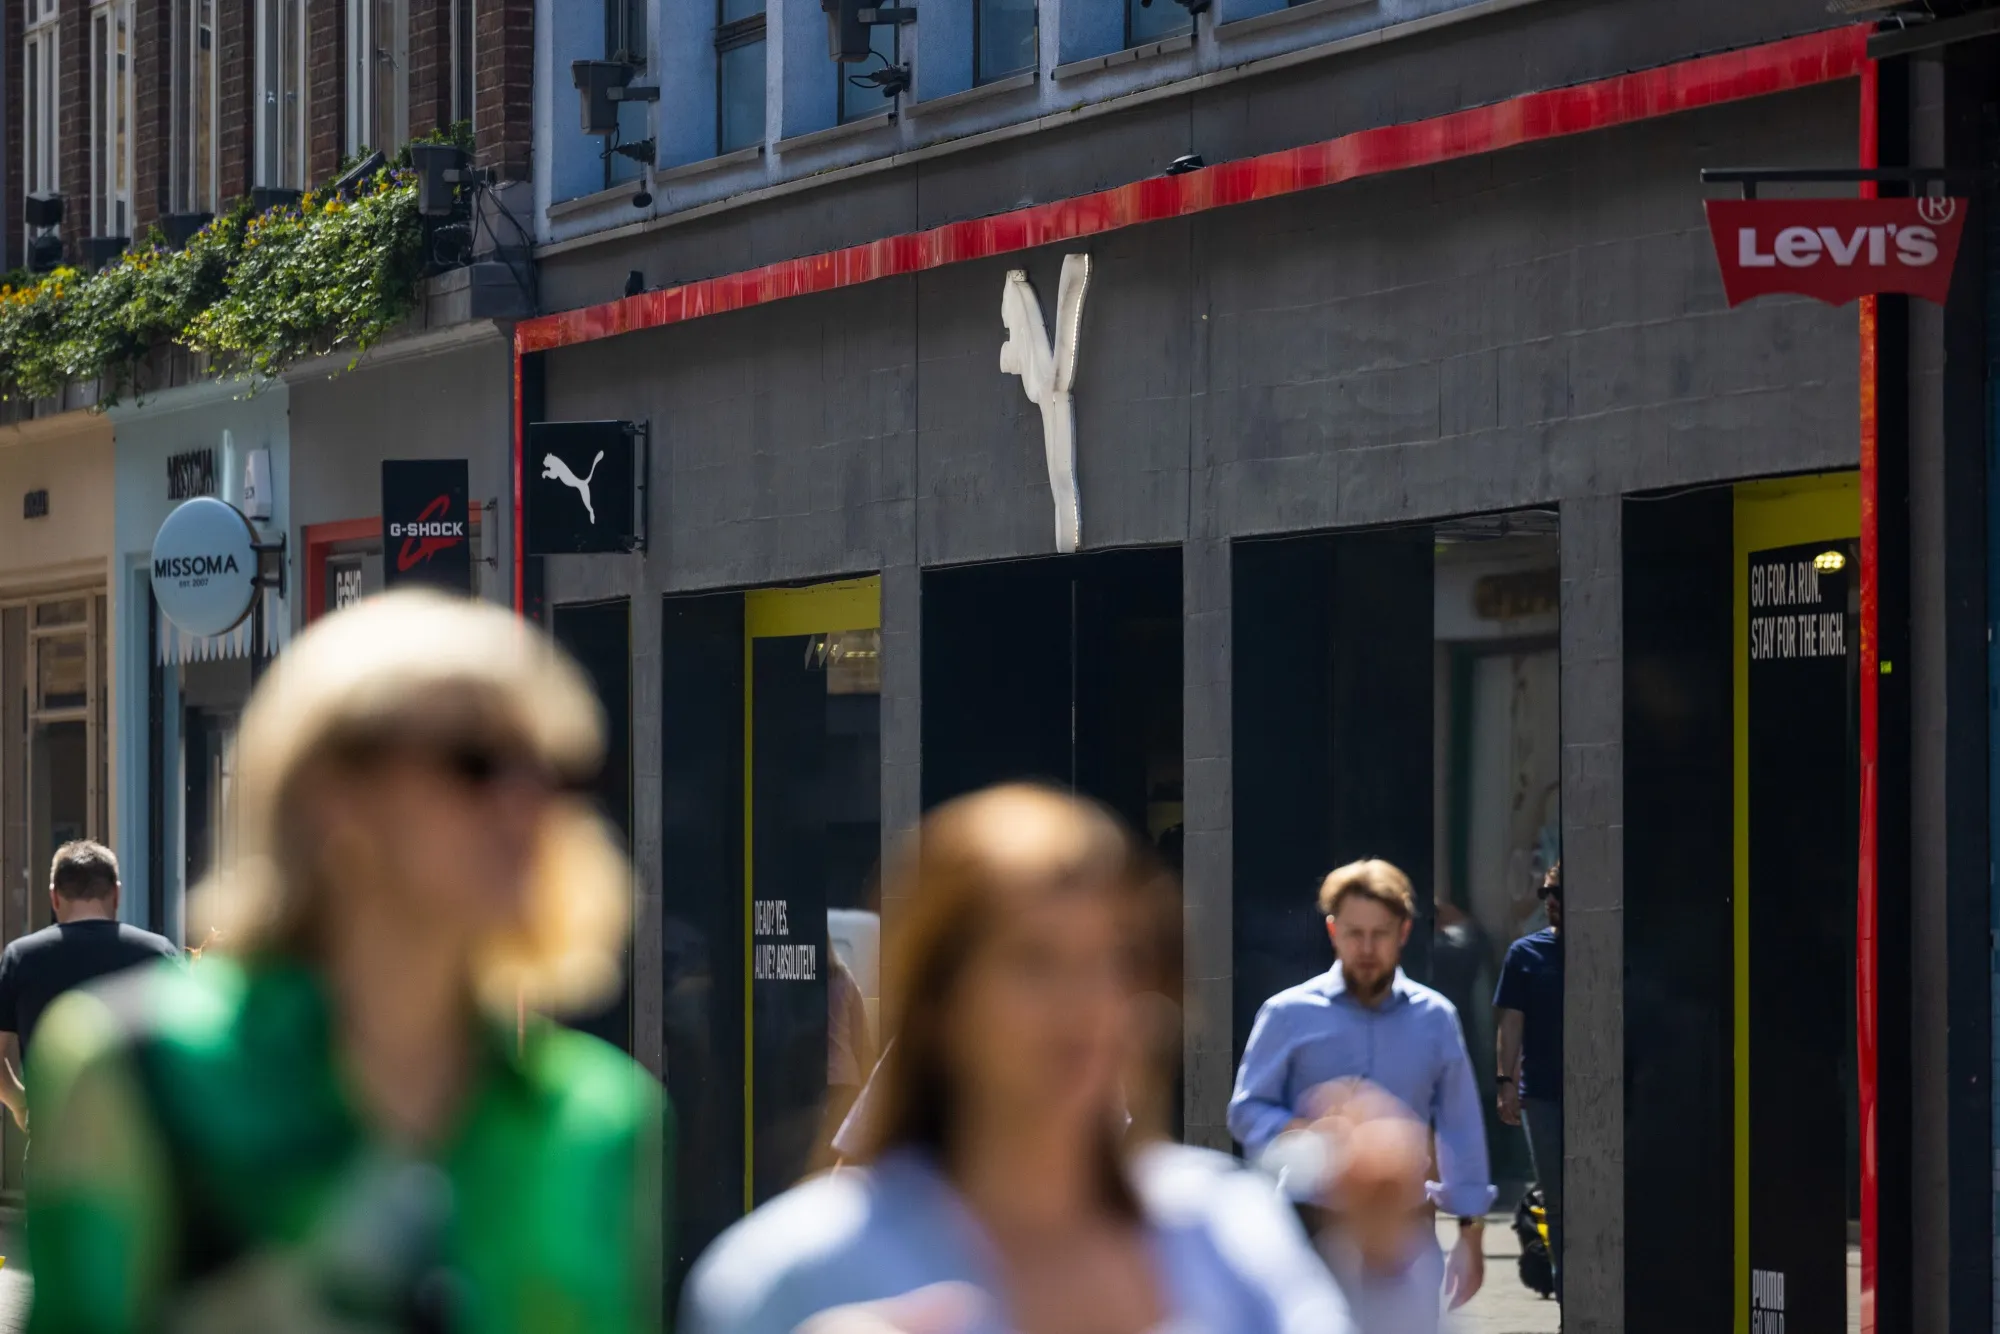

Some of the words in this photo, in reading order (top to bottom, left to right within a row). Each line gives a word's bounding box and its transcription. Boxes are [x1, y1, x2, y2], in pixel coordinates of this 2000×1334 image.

[390, 522, 463, 537] G-SHOCK
[154, 555, 239, 578] MISSOMA
[192, 578, 209, 588] 2007
[1751, 564, 1764, 608] GO
[1767, 563, 1786, 606] FOR
[1788, 562, 1796, 605] A
[1798, 560, 1822, 604] RUN.
[1751, 616, 1775, 660] STAY
[1777, 615, 1796, 658] FOR
[1798, 614, 1817, 657] THE
[1819, 612, 1847, 656] HIGH.
[755, 900, 775, 936] DEAD?
[775, 900, 789, 936] YES.
[755, 944, 776, 980] ALIVE?
[776, 944, 816, 980] ABSOLUTELY!
[1752, 1269, 1785, 1311] PUMA
